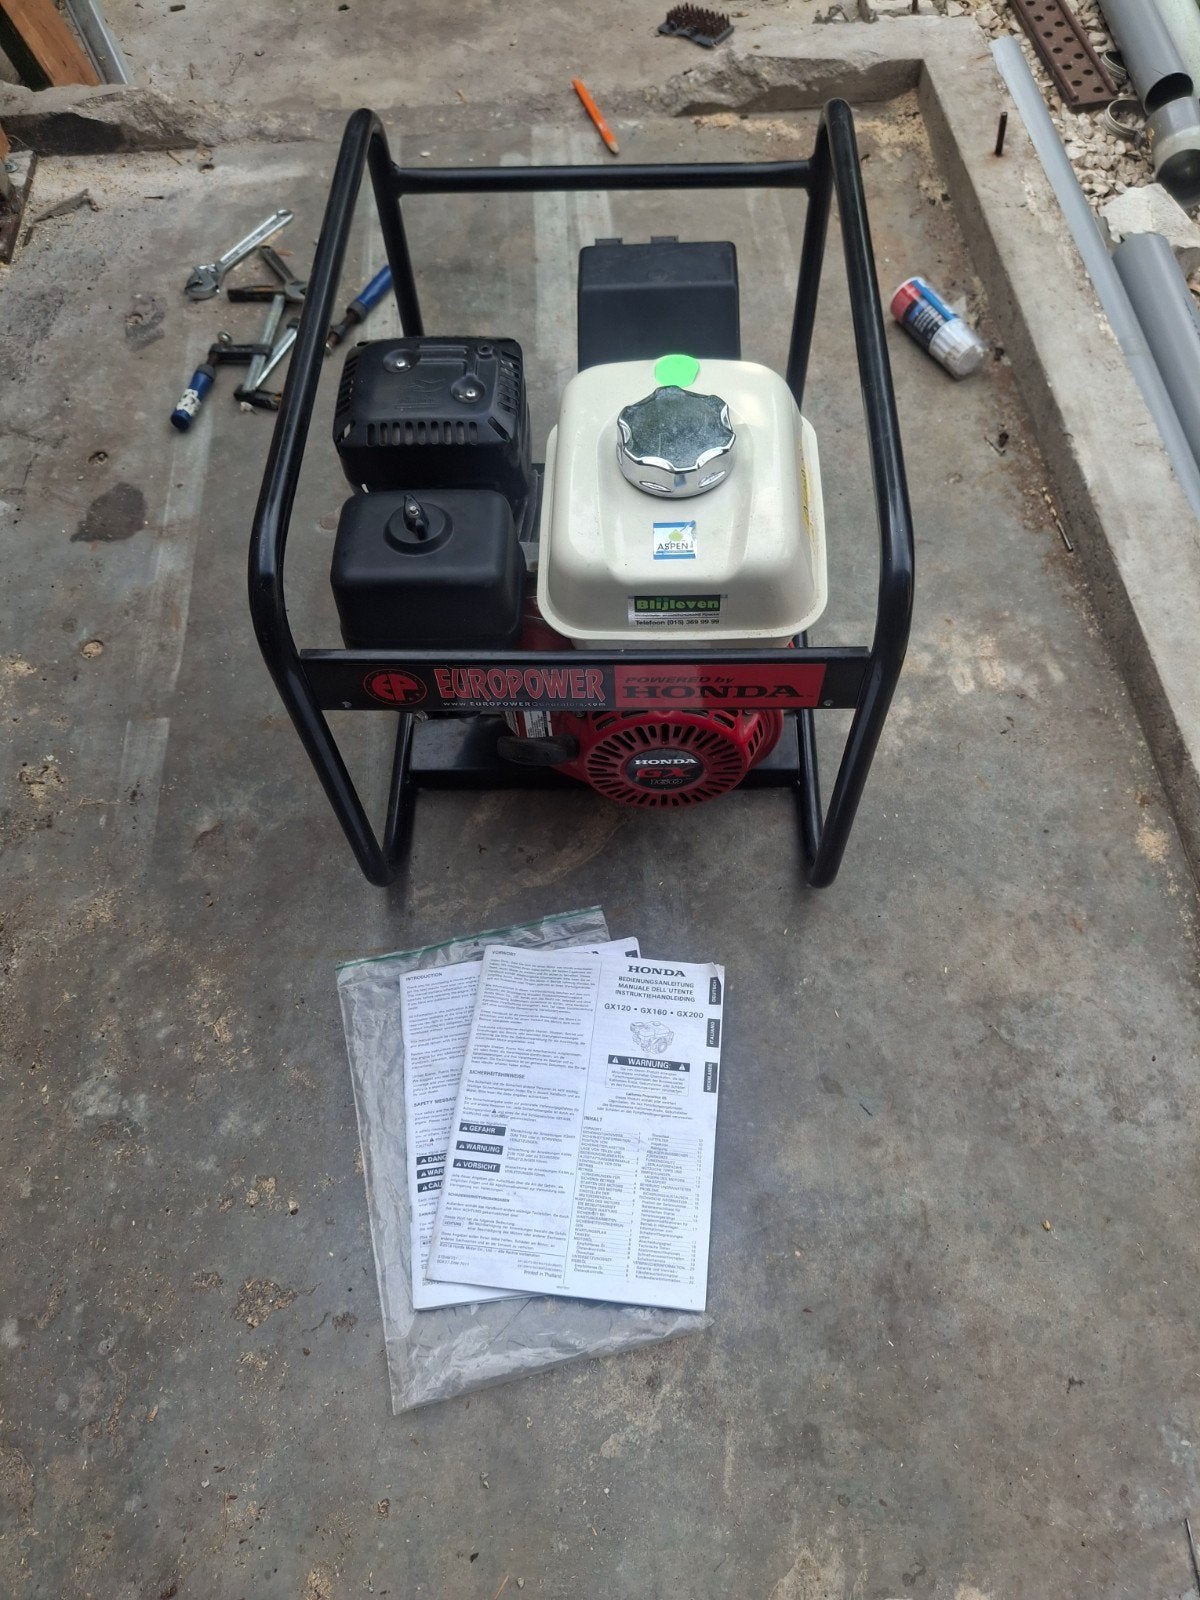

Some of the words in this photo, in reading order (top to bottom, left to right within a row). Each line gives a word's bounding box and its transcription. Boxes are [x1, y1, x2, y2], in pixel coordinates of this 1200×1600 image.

[657, 542, 689, 551] ASPEN
[636, 598, 719, 611] Blijleven
[434, 668, 606, 702] EUROPOWER
[714, 676, 735, 684] by
[622, 684, 805, 699] HONDA
[628, 965, 686, 977] HONDA
[405, 972, 443, 981] INTRODUCTION
[618, 976, 695, 988] BEDIENUNGSANLEITUNG
[618, 983, 650, 992] MANUALE
[604, 1003, 632, 1012] GX120
[640, 1007, 668, 1016] GX160
[676, 1010, 704, 1019] GX200
[469, 1125, 496, 1134] GEFAHR
[465, 1143, 501, 1153] WARNUNG
[463, 1161, 497, 1171] VORSICHT
